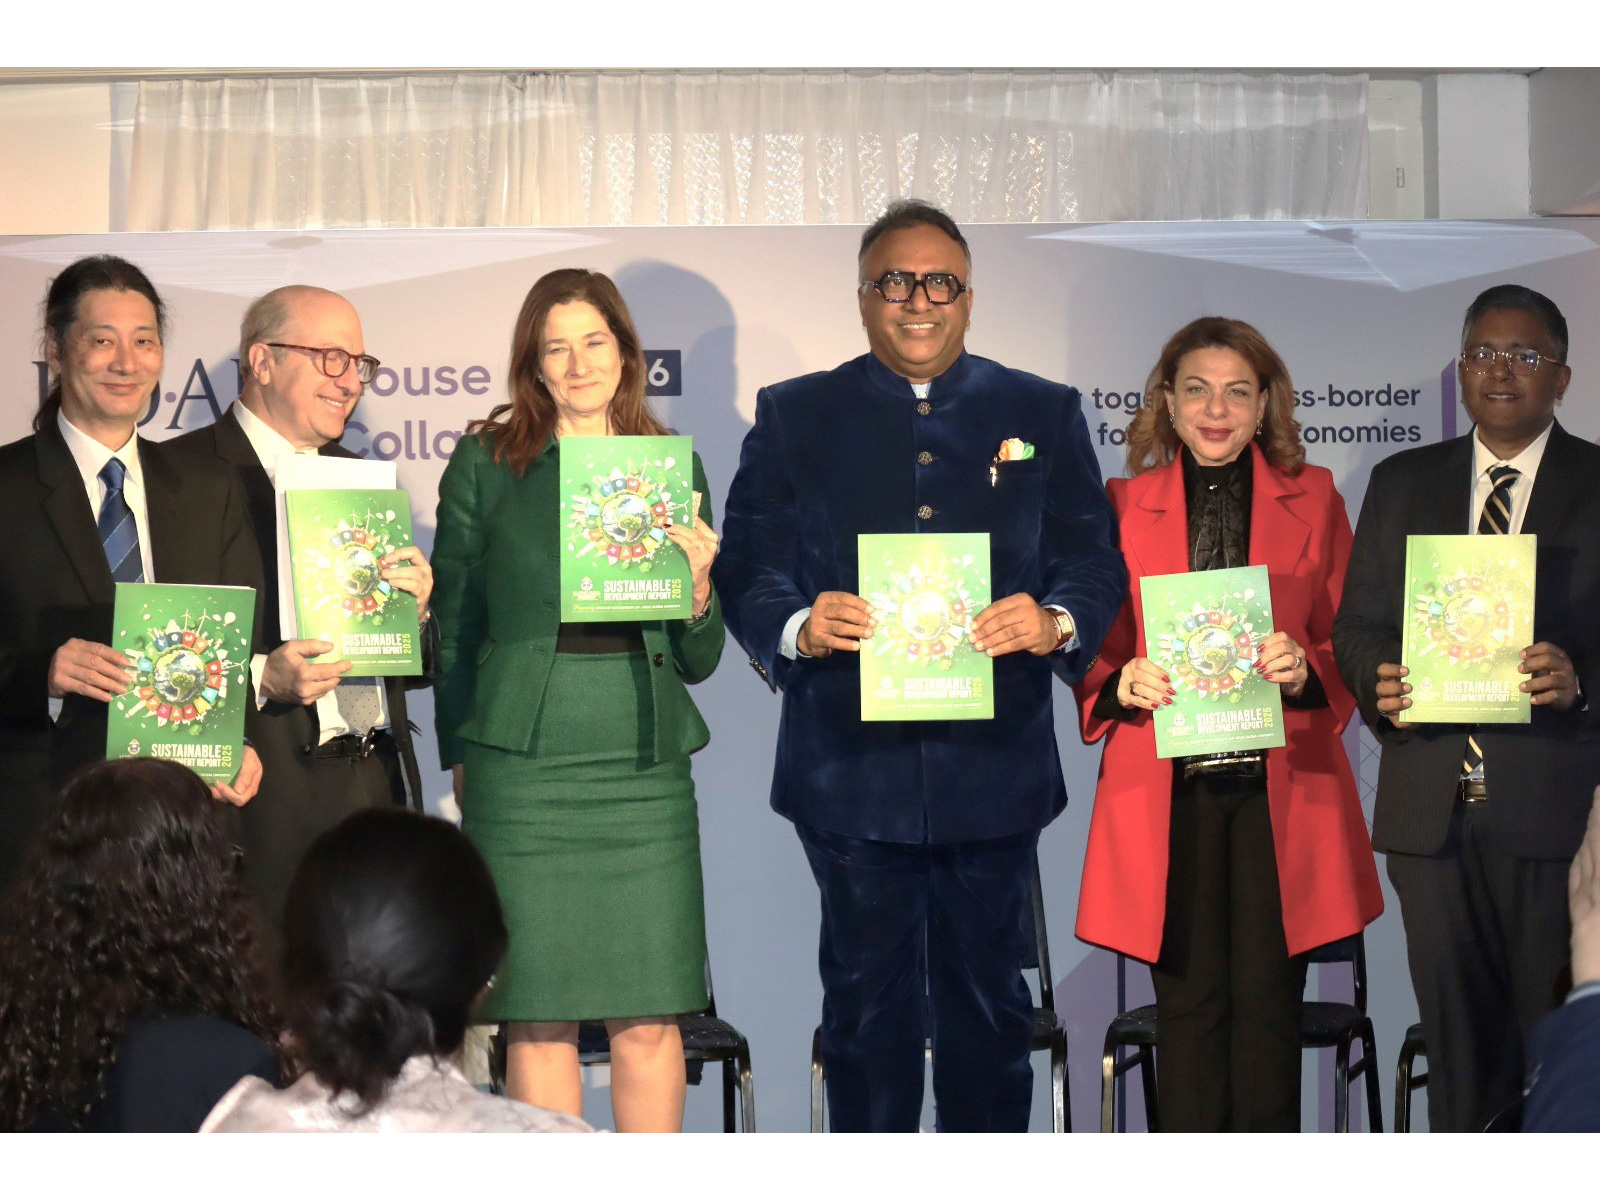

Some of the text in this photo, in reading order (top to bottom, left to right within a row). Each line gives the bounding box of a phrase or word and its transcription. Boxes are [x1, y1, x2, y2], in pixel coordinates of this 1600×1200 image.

[361, 366, 491, 397] ouse
[648, 358, 670, 387] 6
[1092, 387, 1149, 415] tog
[344, 419, 475, 461] Colla
[1097, 418, 1422, 446] fo onomies
[603, 579, 671, 593] SUSTAINABLE
[671, 578, 682, 599] 2025
[603, 592, 648, 601] DEVELOPMENT
[648, 591, 672, 600] REPORT
[342, 633, 402, 647] SUSTAINABLE
[402, 633, 412, 654] 2025
[382, 646, 403, 655] REPORT
[1442, 680, 1511, 693] SUSTAINABLE
[1443, 693, 1486, 702] DEVELOPMENT
[1486, 693, 1511, 702] REPORT
[1196, 707, 1263, 726] SUSTAINABLE
[1262, 707, 1274, 728] 2025
[1197, 721, 1241, 734] DEVELOPMENT
[1240, 720, 1264, 730] REPORT
[151, 743, 222, 759] SUSTAINABLE
[221, 744, 232, 767] 2025
[196, 757, 222, 768] REPORT
